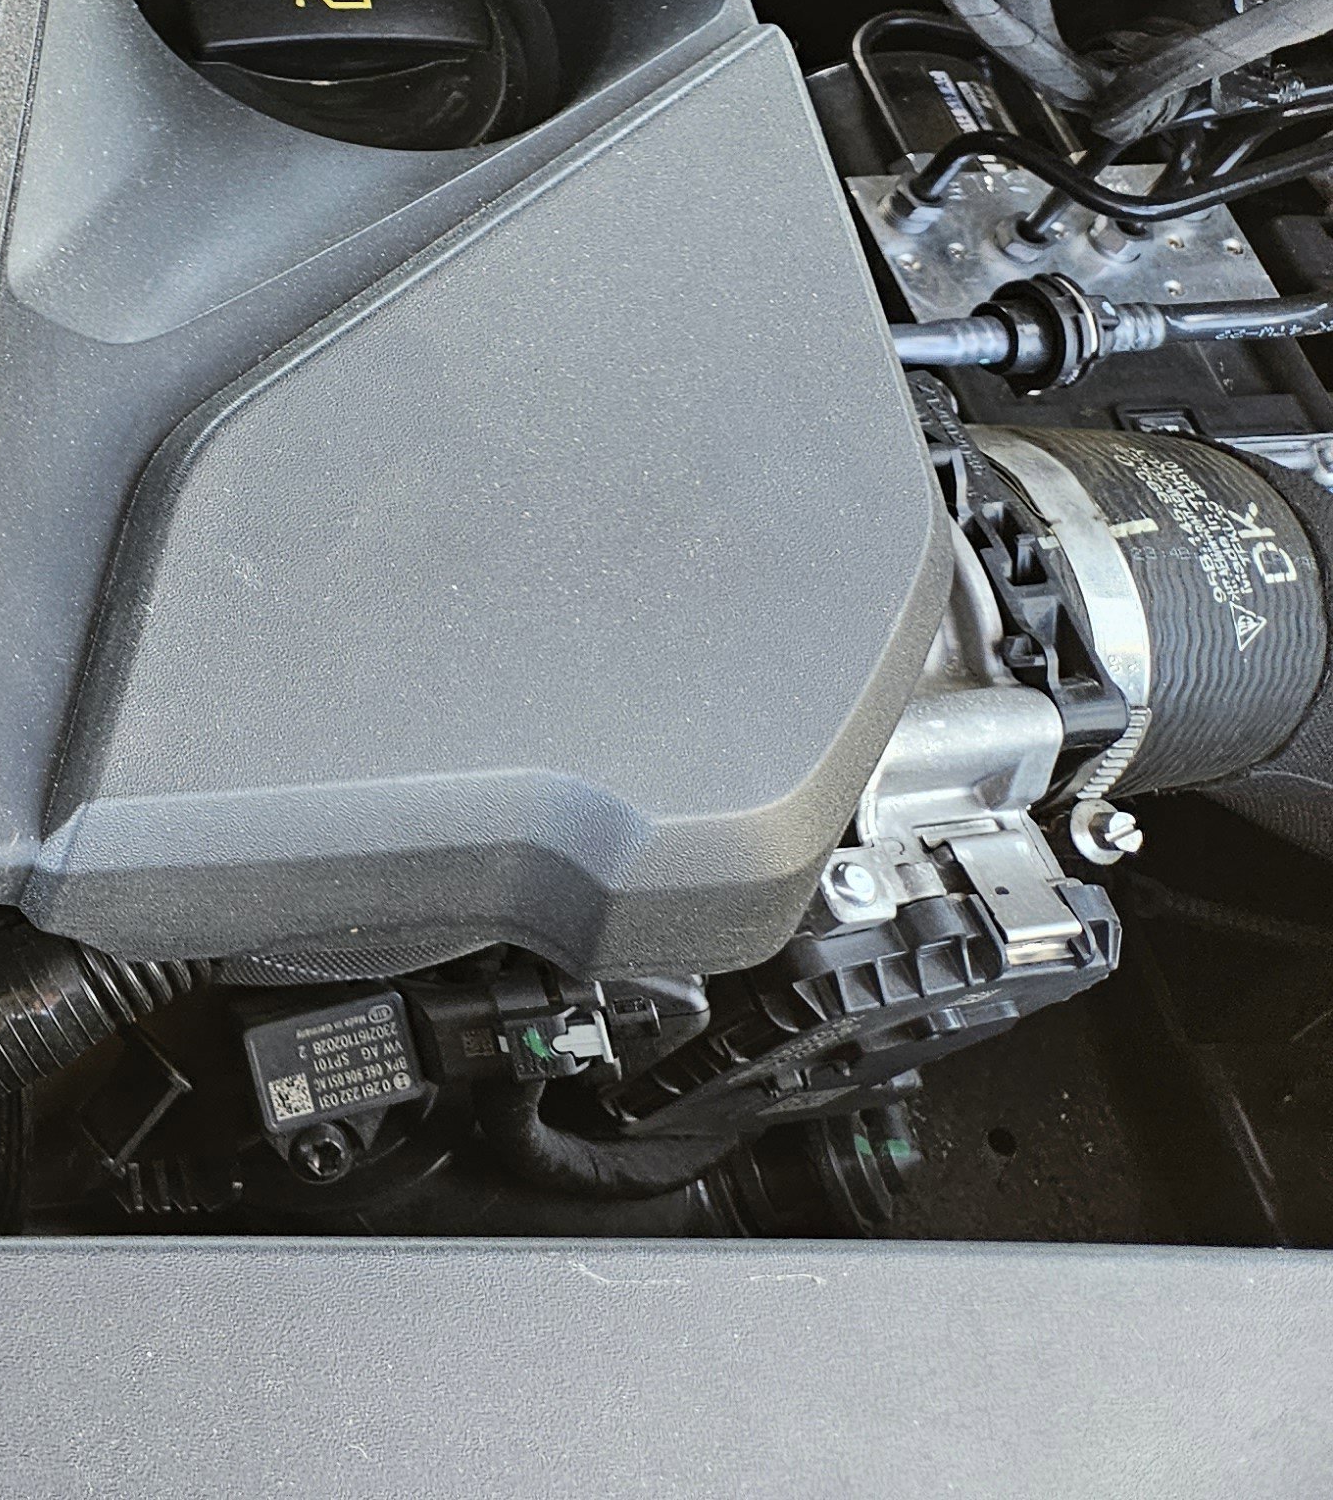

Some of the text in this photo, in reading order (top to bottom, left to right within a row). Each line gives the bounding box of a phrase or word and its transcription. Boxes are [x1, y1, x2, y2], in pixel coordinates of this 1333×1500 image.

[297, 1045, 308, 1060] 2
[360, 1044, 380, 1061] AG
[383, 1040, 405, 1056] VW
[318, 1079, 393, 1110] 0 261 232 031
